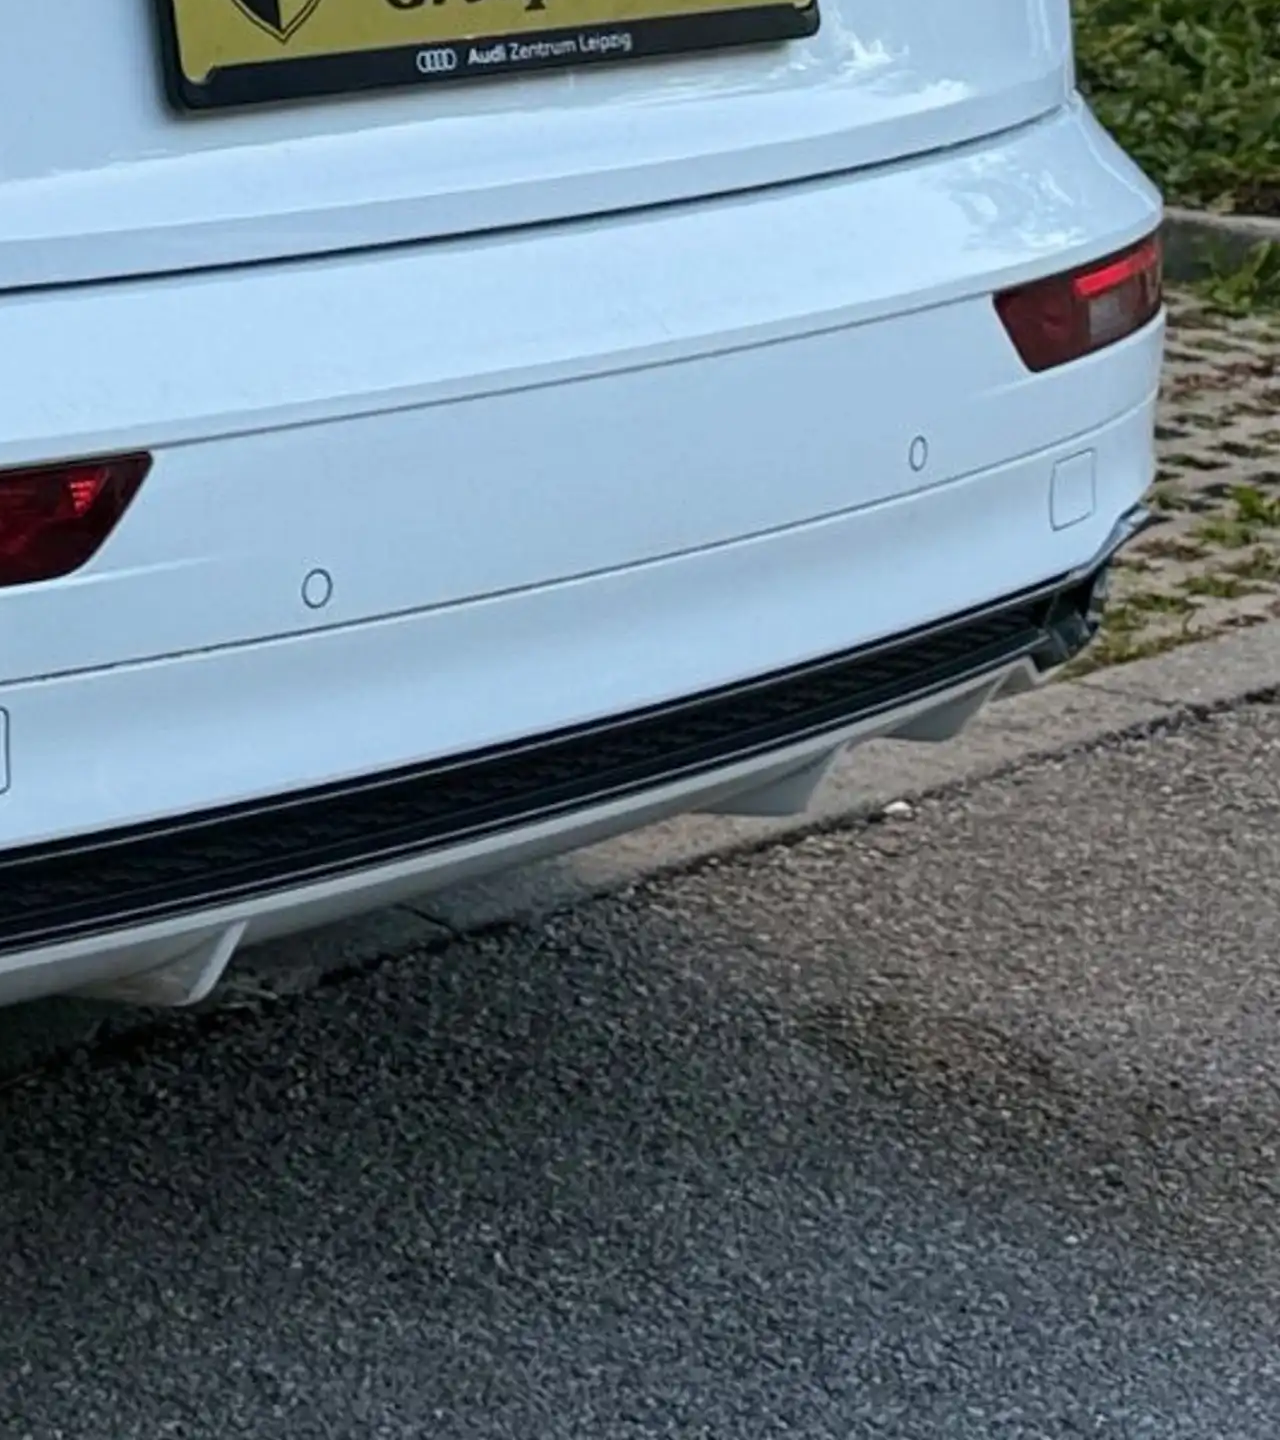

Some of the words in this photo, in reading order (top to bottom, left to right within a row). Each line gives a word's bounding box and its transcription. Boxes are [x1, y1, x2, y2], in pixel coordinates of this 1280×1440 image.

[467, 47, 507, 65] Audi
[509, 39, 577, 60] Zentrum
[579, 31, 633, 53] Leipzig
